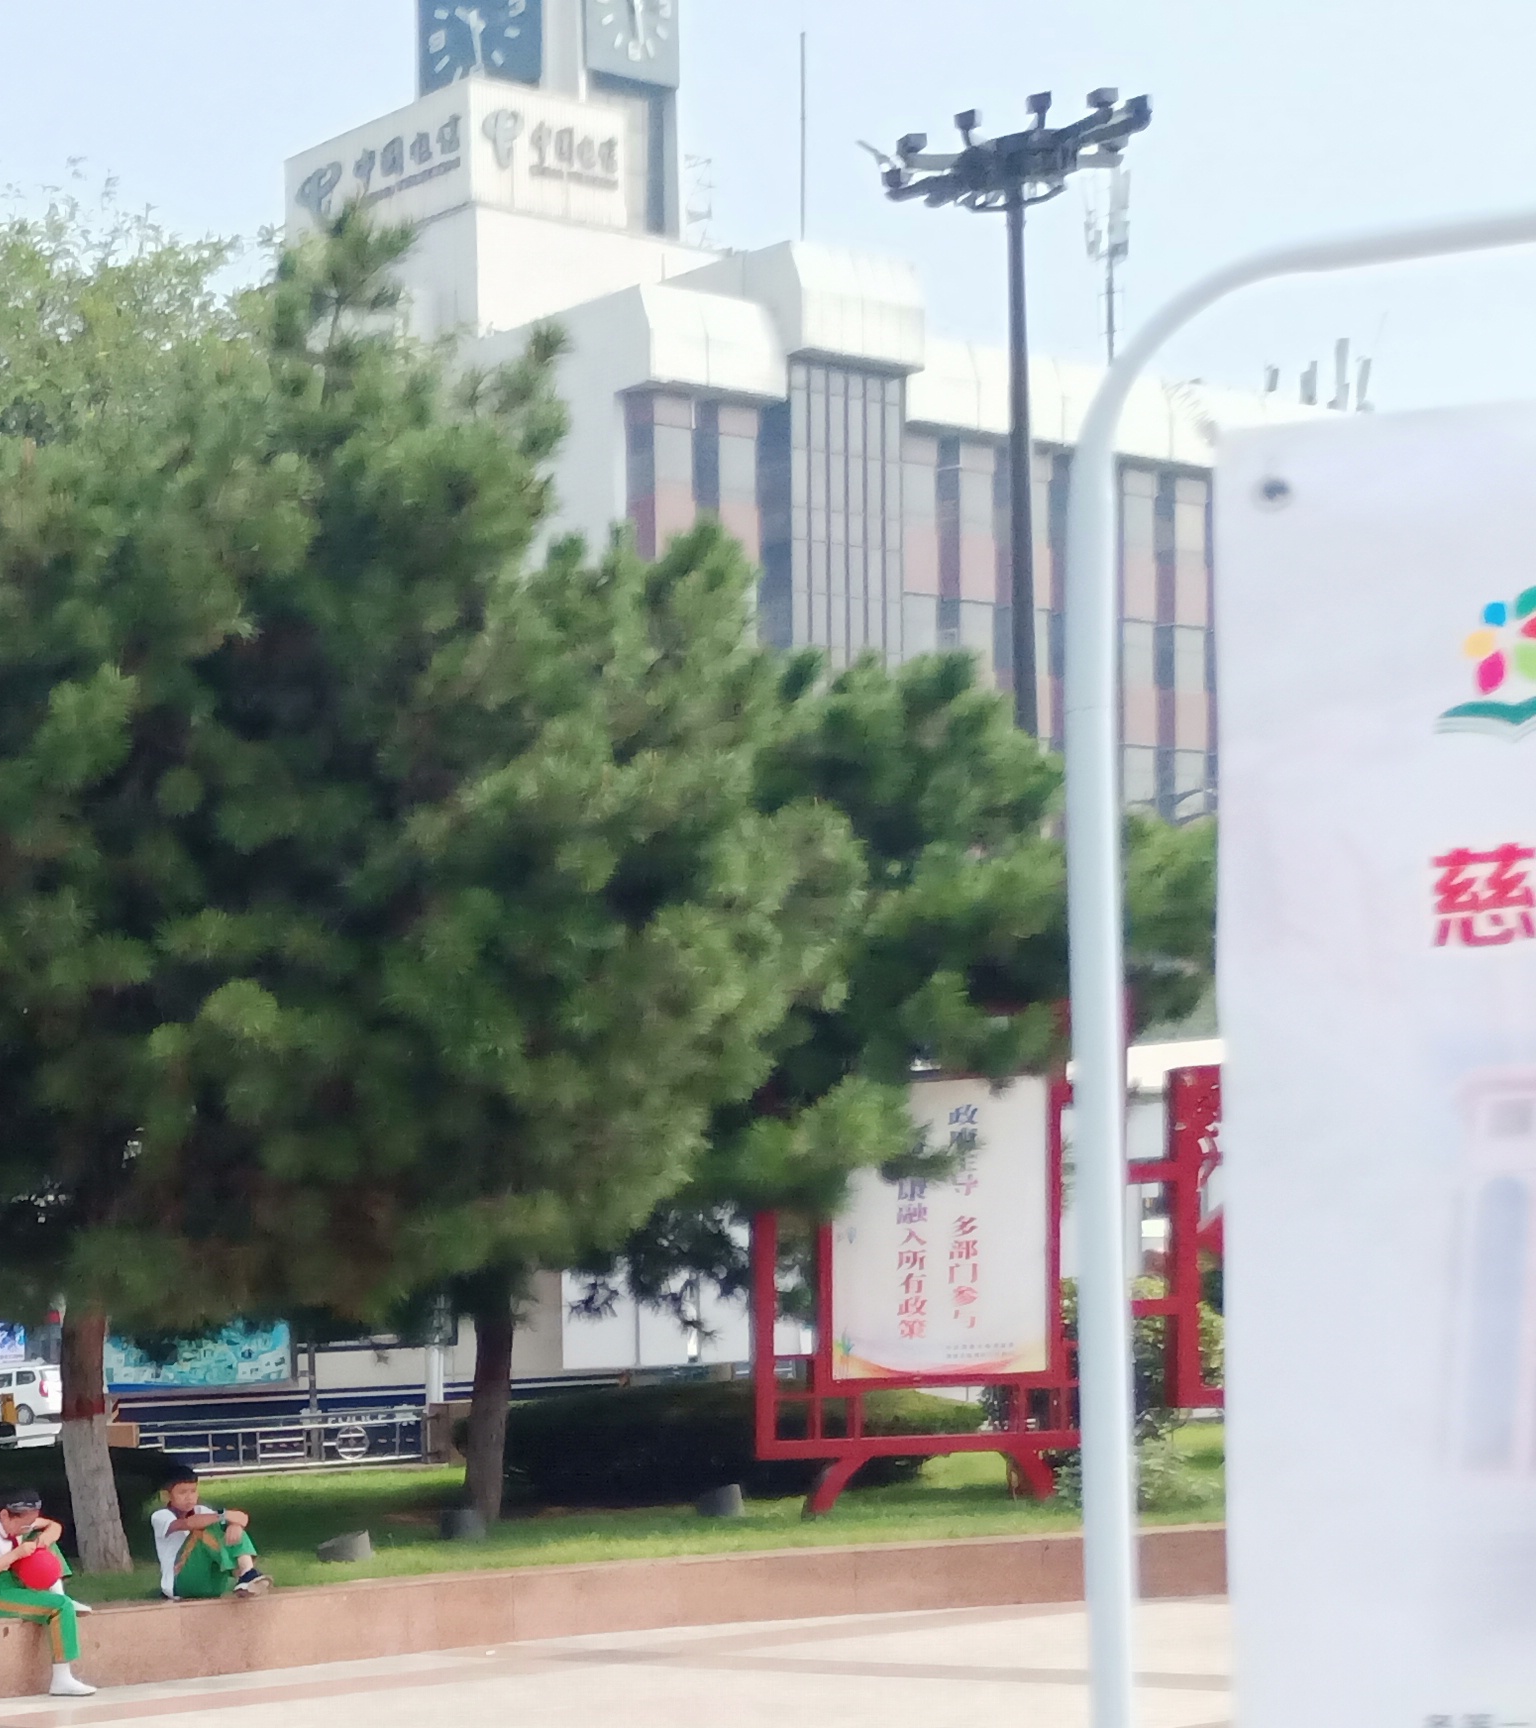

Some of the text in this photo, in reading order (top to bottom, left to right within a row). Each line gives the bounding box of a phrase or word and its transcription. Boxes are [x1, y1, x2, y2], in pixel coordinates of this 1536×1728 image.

[530, 120, 619, 174] 中国电信
[1430, 843, 1535, 947] 慈
[948, 1215, 979, 1329] 多部门参与
